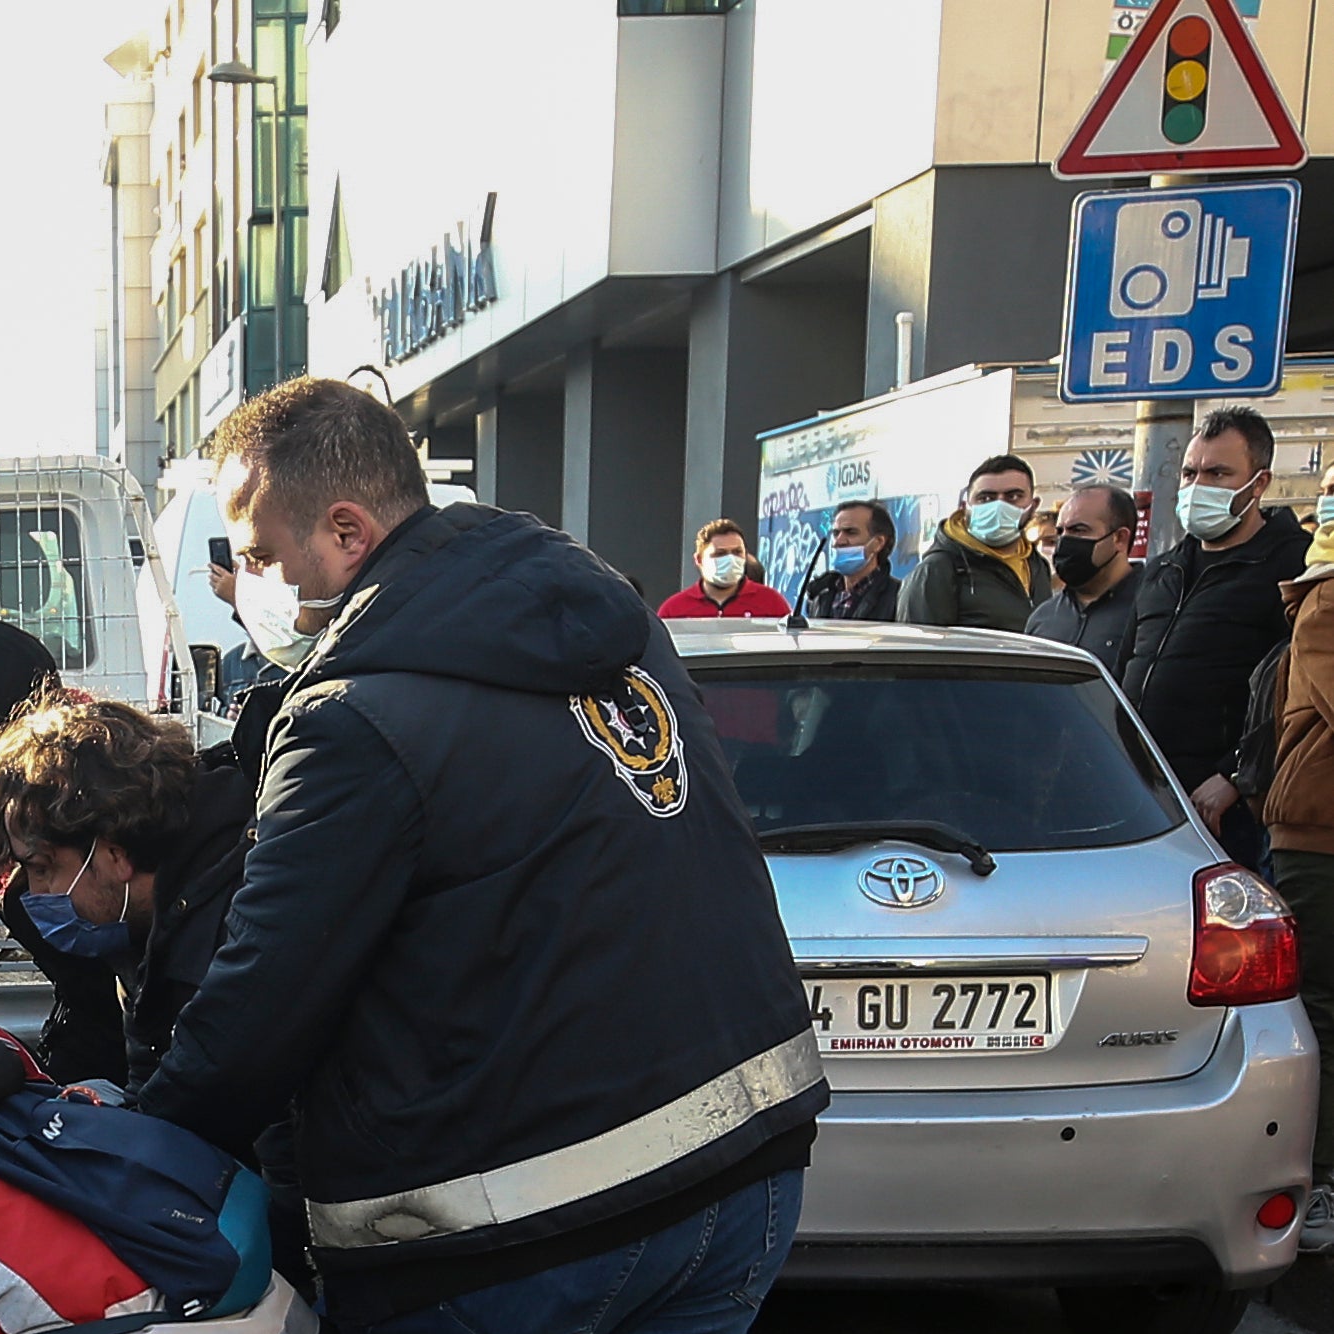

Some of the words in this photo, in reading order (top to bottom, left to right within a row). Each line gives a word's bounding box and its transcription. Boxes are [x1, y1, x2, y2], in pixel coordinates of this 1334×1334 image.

[1090, 324, 1256, 387] EDS
[857, 984, 909, 1031] GU
[932, 983, 1037, 1030] 2772
[830, 1036, 896, 1050] EMIRHAN
[900, 1035, 975, 1049] OTOMOTIV
